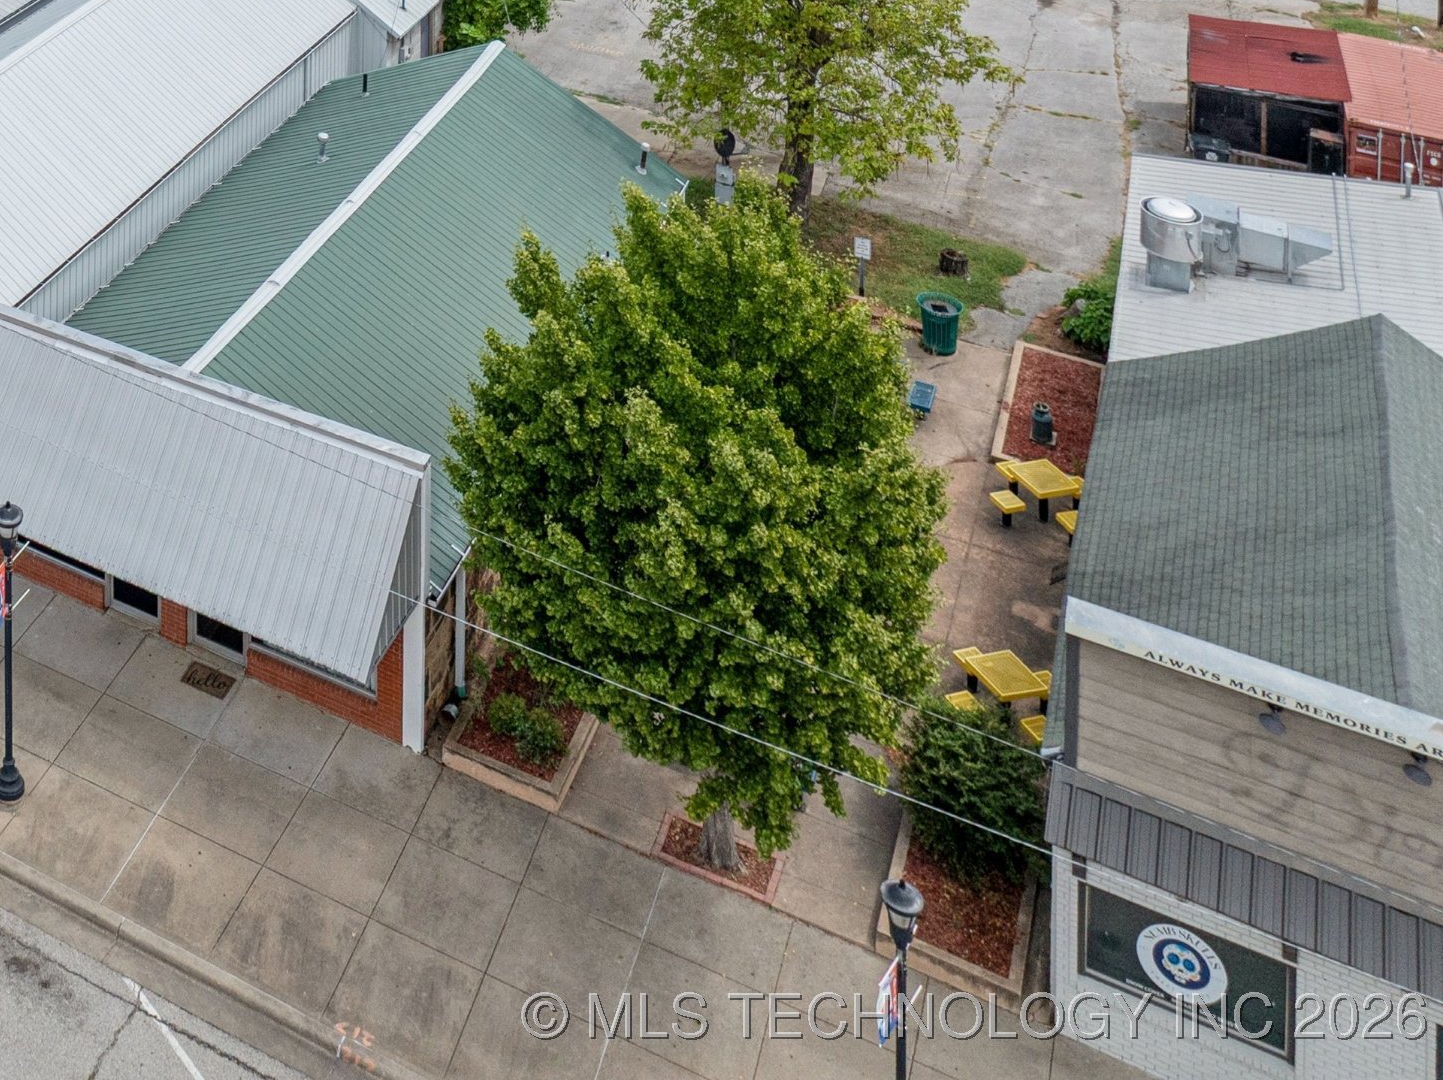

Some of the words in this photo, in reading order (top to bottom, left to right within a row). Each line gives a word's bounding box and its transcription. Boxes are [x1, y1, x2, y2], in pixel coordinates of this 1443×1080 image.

[187, 669, 227, 690] hello
[1144, 650, 1221, 682] ALWAYS
[1229, 678, 1287, 705] MAKE
[1295, 700, 1408, 745] MEMORIES
[1144, 926, 1176, 940] NUMB
[1178, 930, 1222, 970] SKULLS
